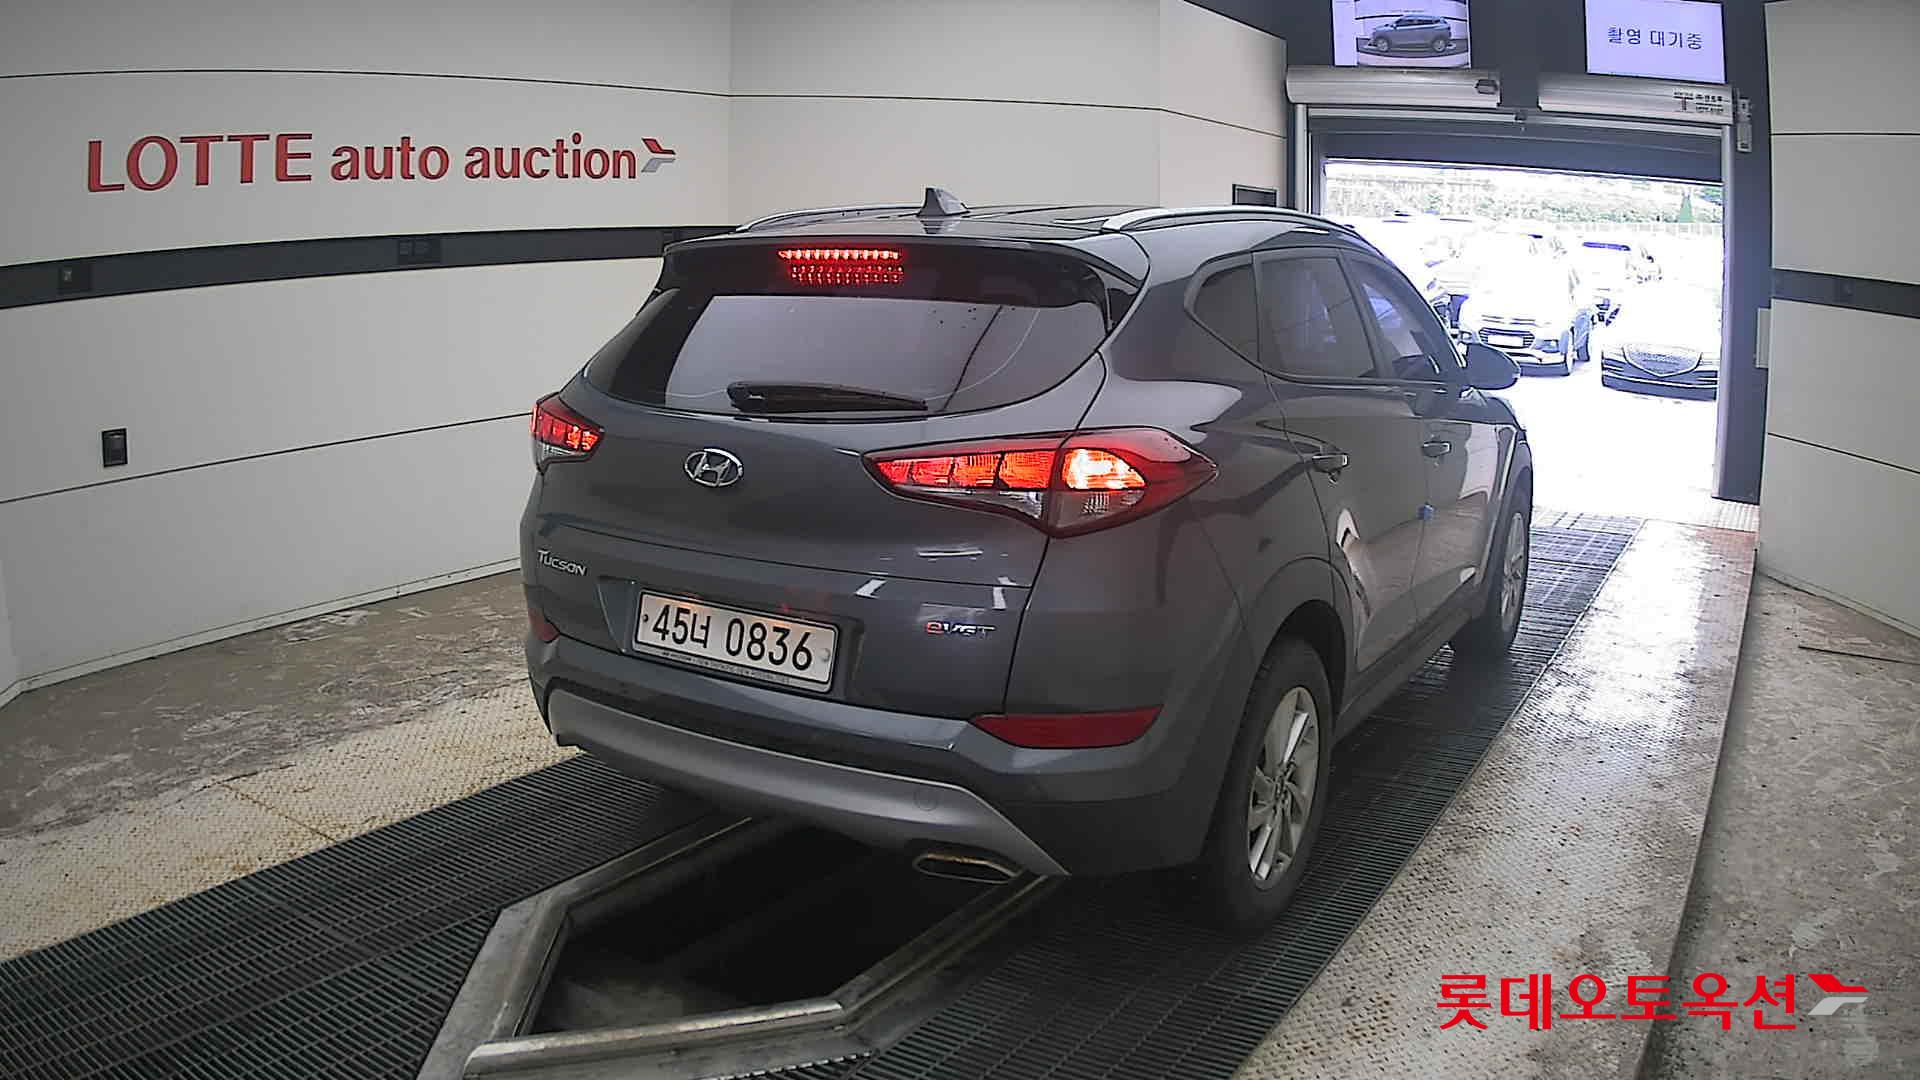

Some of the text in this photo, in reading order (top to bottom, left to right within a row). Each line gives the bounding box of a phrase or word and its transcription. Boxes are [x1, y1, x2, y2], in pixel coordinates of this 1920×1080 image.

[1607, 26, 1703, 50] 촬영 대기중
[87, 132, 637, 193] LOTTE auto auction
[537, 549, 588, 576] TUCSON
[653, 603, 711, 649] 45너
[726, 616, 814, 672] 0836
